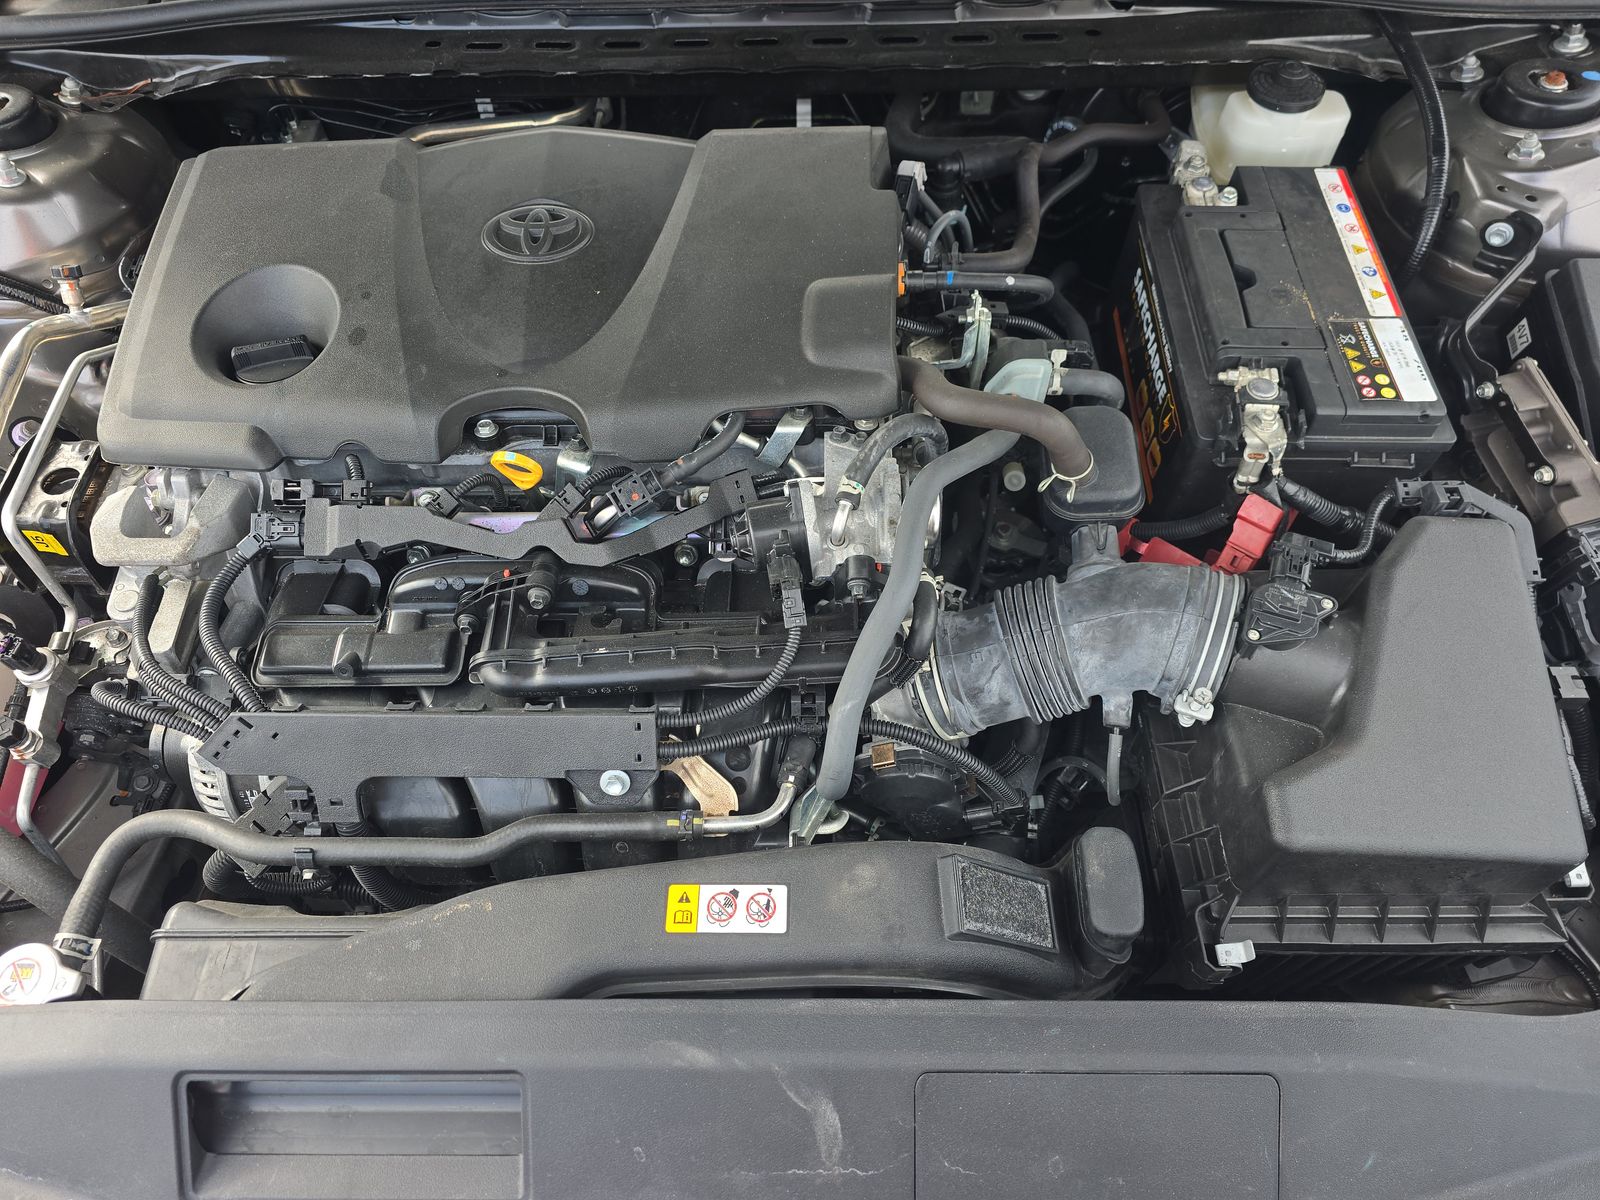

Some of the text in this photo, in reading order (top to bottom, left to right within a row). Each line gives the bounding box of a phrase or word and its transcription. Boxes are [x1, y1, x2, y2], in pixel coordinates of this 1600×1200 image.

[1133, 267, 1167, 405] SAFECHARGE
[1517, 324, 1529, 346] 4V7
[30, 535, 50, 548] J5
